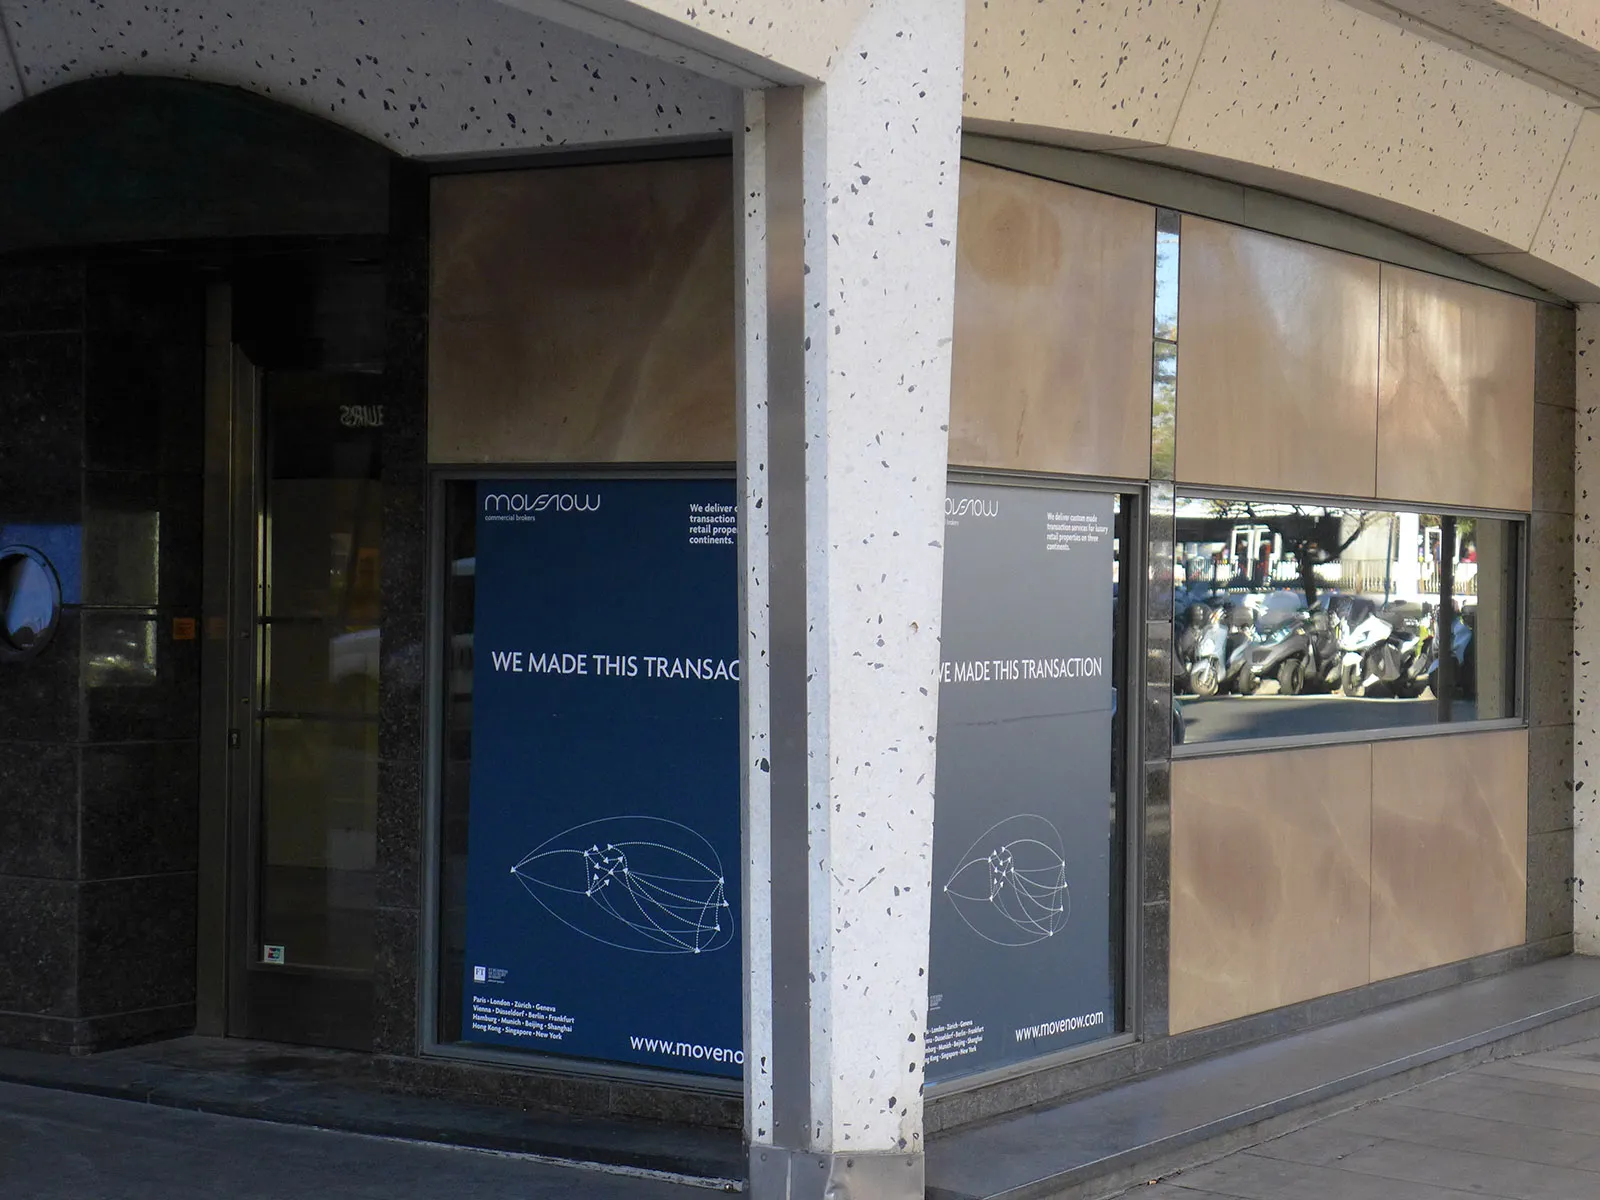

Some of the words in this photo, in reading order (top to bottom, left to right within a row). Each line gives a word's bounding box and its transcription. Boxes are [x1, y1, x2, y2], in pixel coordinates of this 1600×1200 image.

[690, 503, 704, 513] We
[705, 503, 733, 513] deliver
[485, 514, 516, 522] commercial
[516, 514, 536, 522] brokers
[689, 514, 736, 524] transaction
[1047, 512, 1054, 520] We
[1055, 512, 1069, 521] deliver
[689, 525, 711, 534] retail
[1047, 523, 1071, 531] transaction
[1096, 524, 1108, 535] luxury
[689, 535, 734, 544] continents.
[1059, 534, 1080, 543] properties
[492, 651, 523, 673] WE
[528, 653, 588, 676] MADE
[593, 655, 638, 677] THIS
[955, 660, 990, 682] MADE
[993, 659, 1019, 681] THIS
[1022, 656, 1102, 680] TRANSACTION
[473, 996, 487, 1004] Paris
[490, 998, 511, 1007] London
[535, 1003, 556, 1012] Geneva
[473, 1004, 492, 1013] Vienna
[528, 1012, 545, 1020] Berlin
[548, 1014, 575, 1024] Frankfurt
[472, 1013, 498, 1024] Hamburg
[501, 1017, 522, 1026] Munich
[524, 1020, 544, 1030] Beijing
[547, 1023, 573, 1032] Shanghai
[1015, 1010, 1104, 1042] www.movenow.com
[472, 1022, 487, 1032] Hong
[487, 1024, 502, 1034] Kong
[505, 1026, 533, 1037] Singapore
[549, 1031, 563, 1040] York
